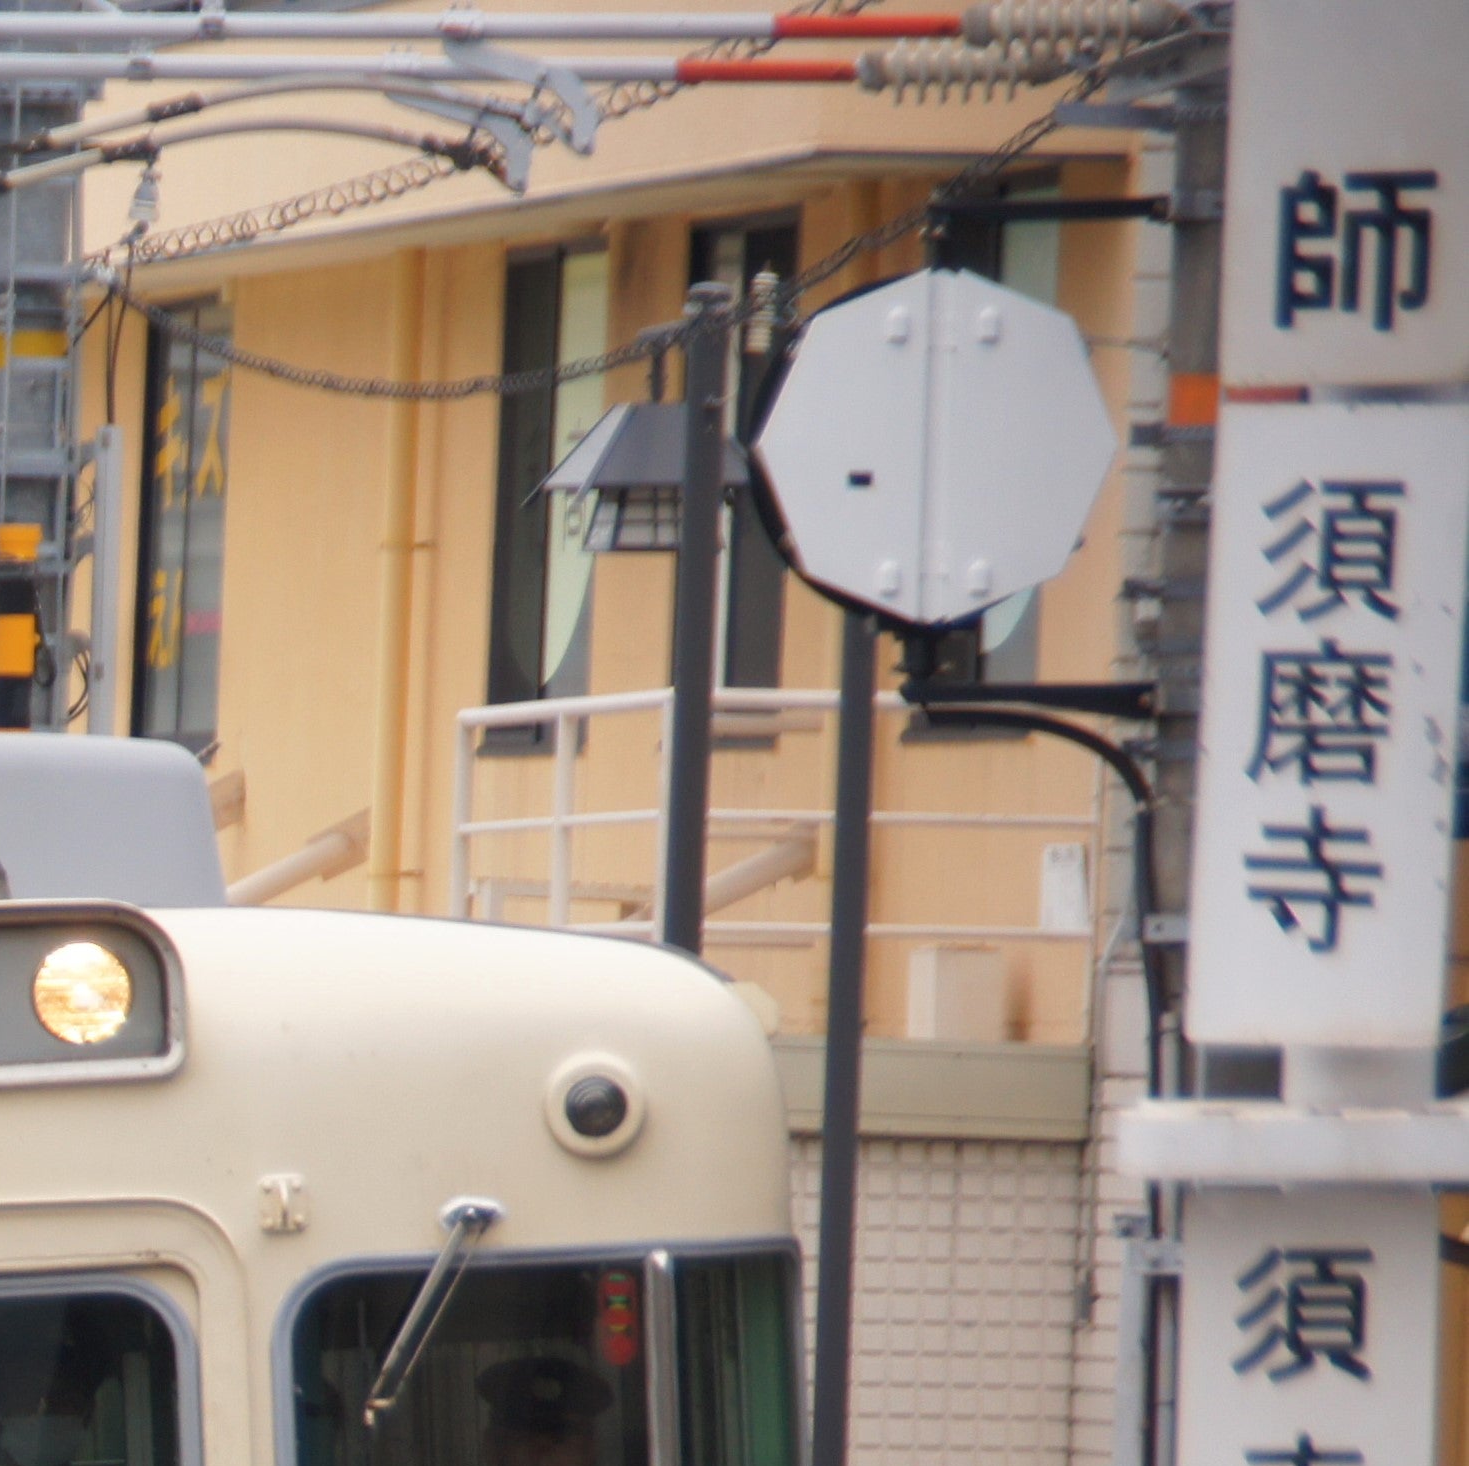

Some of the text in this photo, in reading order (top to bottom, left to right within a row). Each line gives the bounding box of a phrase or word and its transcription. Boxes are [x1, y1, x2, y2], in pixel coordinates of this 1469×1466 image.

[1275, 169, 1438, 332] 師
[1243, 477, 1406, 954] 須磨寺
